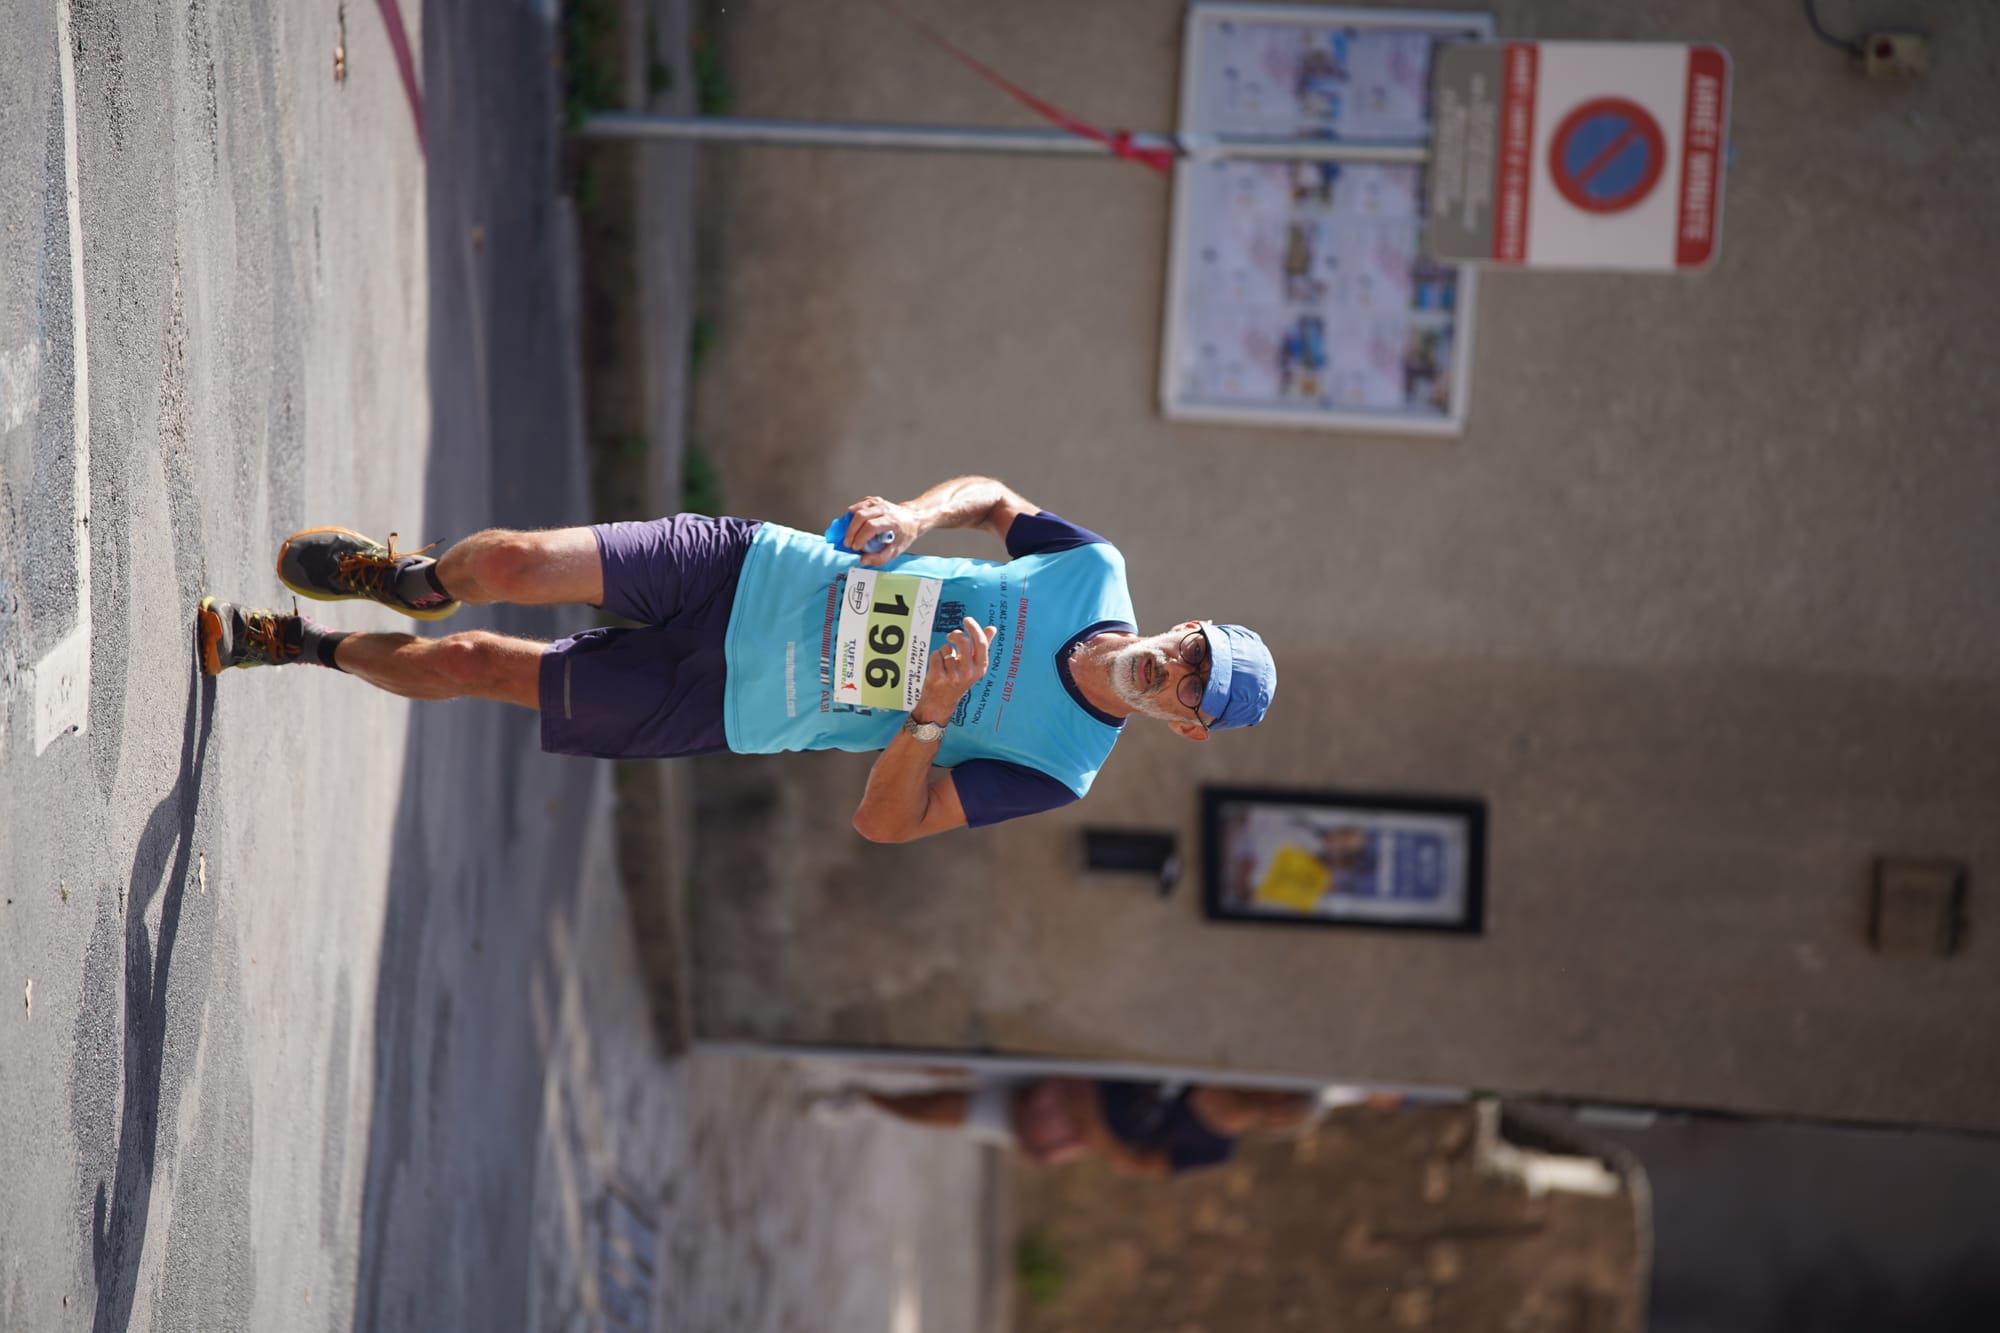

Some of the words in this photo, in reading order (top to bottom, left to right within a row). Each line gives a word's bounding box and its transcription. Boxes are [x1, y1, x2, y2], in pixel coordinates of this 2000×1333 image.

[1682, 151, 1714, 241] MINUTE
[854, 581, 866, 610] BFP
[999, 581, 1008, 591] KM
[991, 600, 1008, 671] SEMI-MARATHON
[1015, 597, 1029, 642] DIMANCHE
[846, 639, 857, 679] TUFF'S
[865, 594, 910, 689] 196
[910, 635, 918, 665] vallées
[1013, 643, 1022, 654] 30
[841, 642, 849, 682] Aventure
[914, 641, 926, 683] Challenge
[1007, 655, 1021, 680] AVRIL
[820, 690, 829, 713] ALBI
[971, 680, 993, 725] MARATHON
[1001, 681, 1014, 702] 2017
